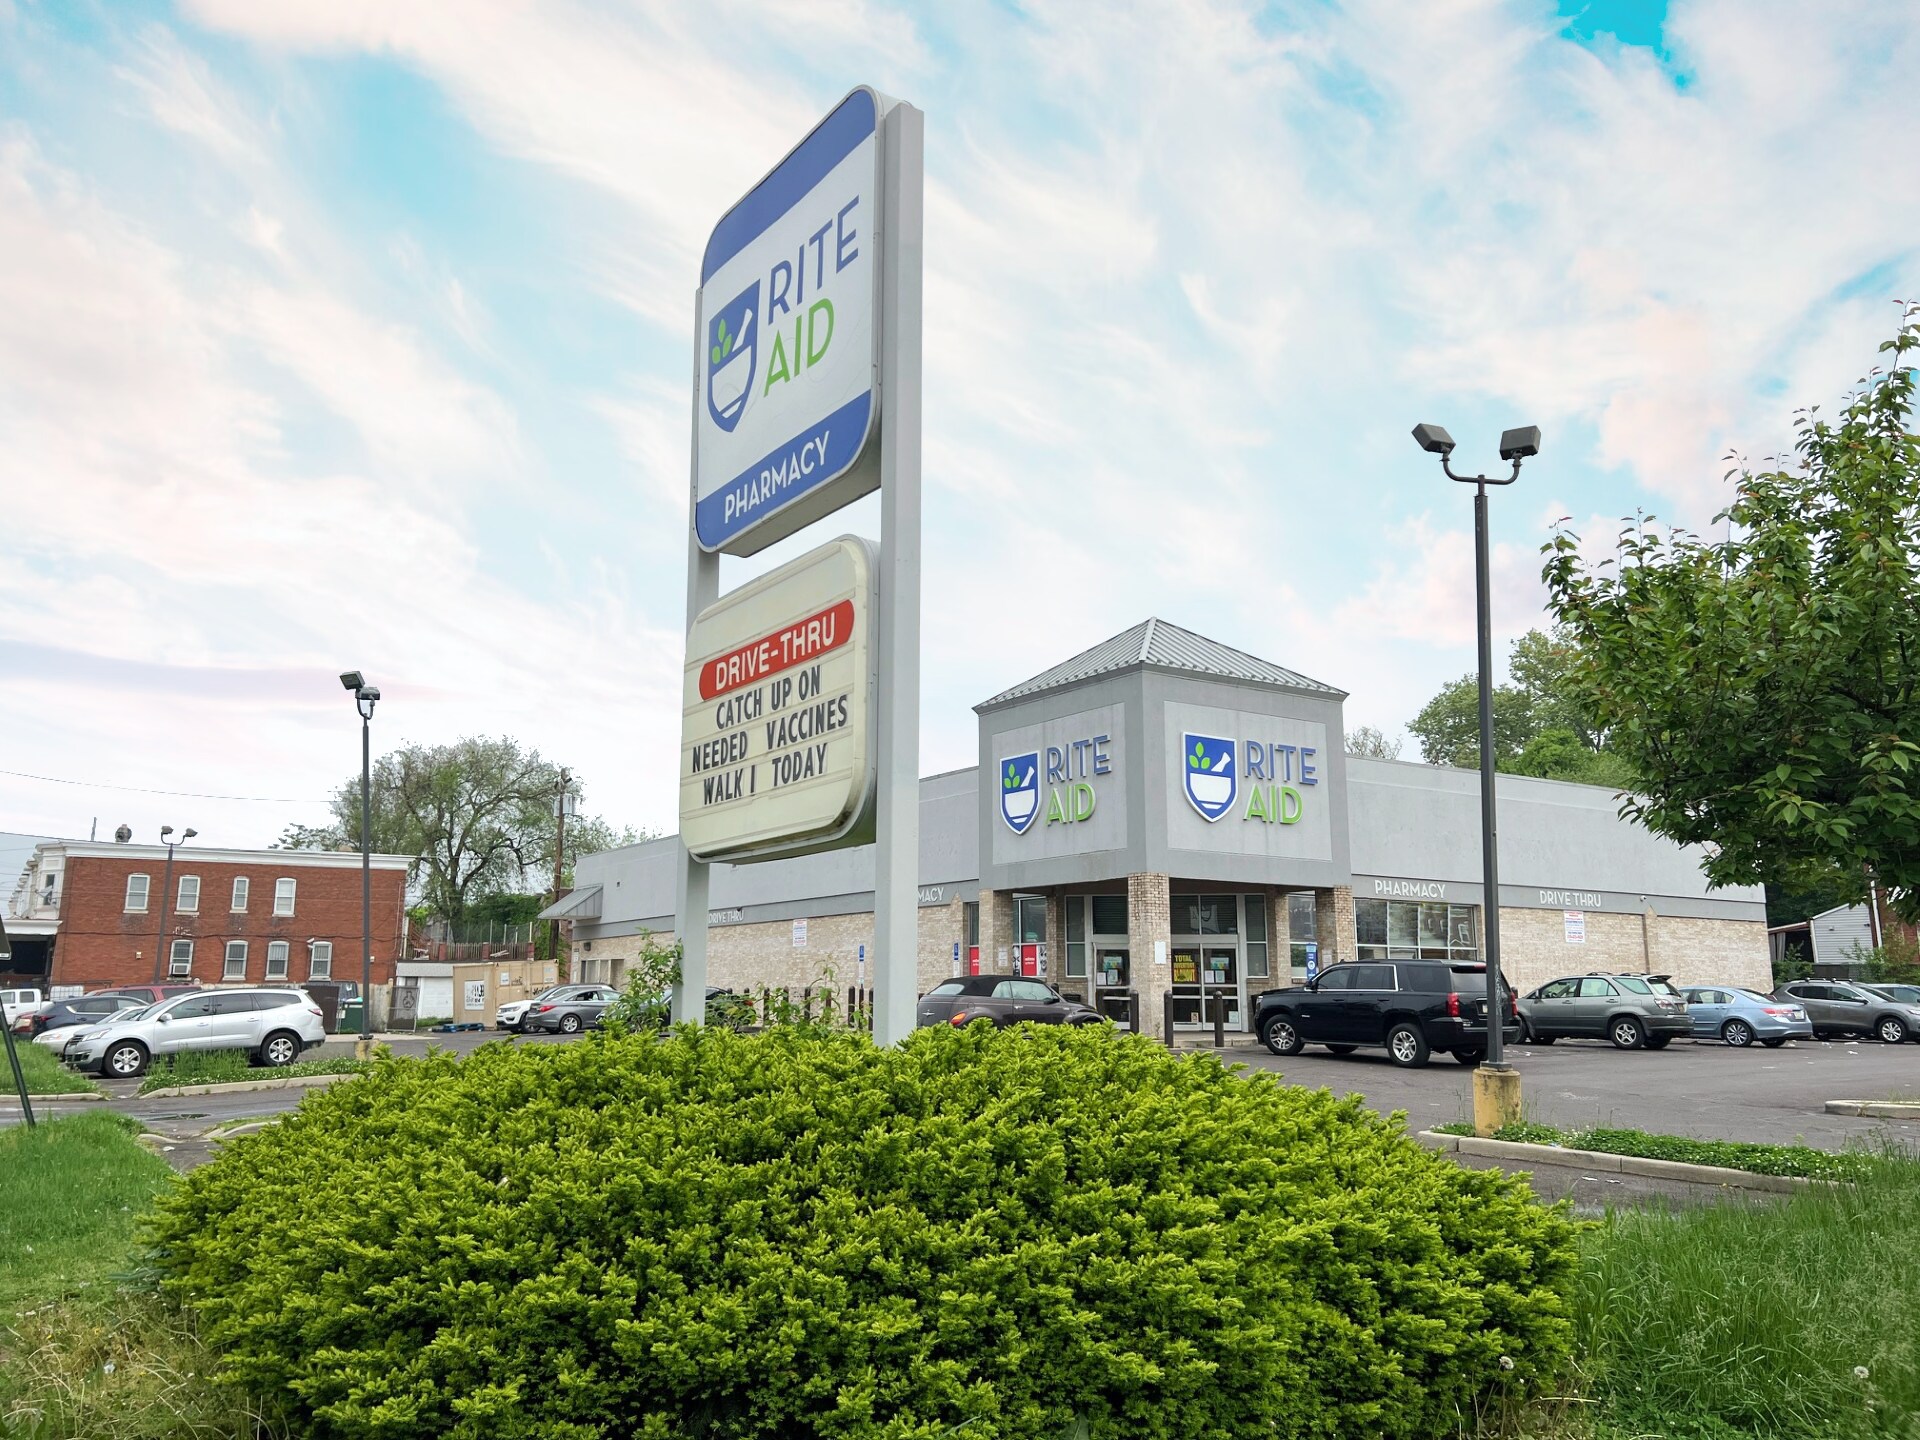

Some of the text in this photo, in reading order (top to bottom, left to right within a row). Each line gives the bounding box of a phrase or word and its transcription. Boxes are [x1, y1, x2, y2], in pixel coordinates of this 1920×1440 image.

[768, 195, 860, 327] RITE
[763, 298, 835, 398] AID
[724, 431, 830, 524] PHARMACY
[715, 611, 836, 691] DRIVE-THRU
[716, 665, 821, 730] CATCH UP ON
[692, 695, 848, 773] NEEDED VACCINES
[703, 766, 743, 805] WALK
[772, 743, 828, 787] TODAY
[1046, 734, 1112, 784] RITE
[1244, 739, 1318, 785] RITE
[1046, 783, 1096, 826] AID
[1243, 784, 1304, 824] AID
[918, 886, 944, 903] MACY
[1374, 879, 1446, 899] PHARMACY
[1539, 890, 1602, 907] DRIVE THRU
[708, 909, 744, 924] DRIVE THRU
[1174, 954, 1193, 962] TOTAL
